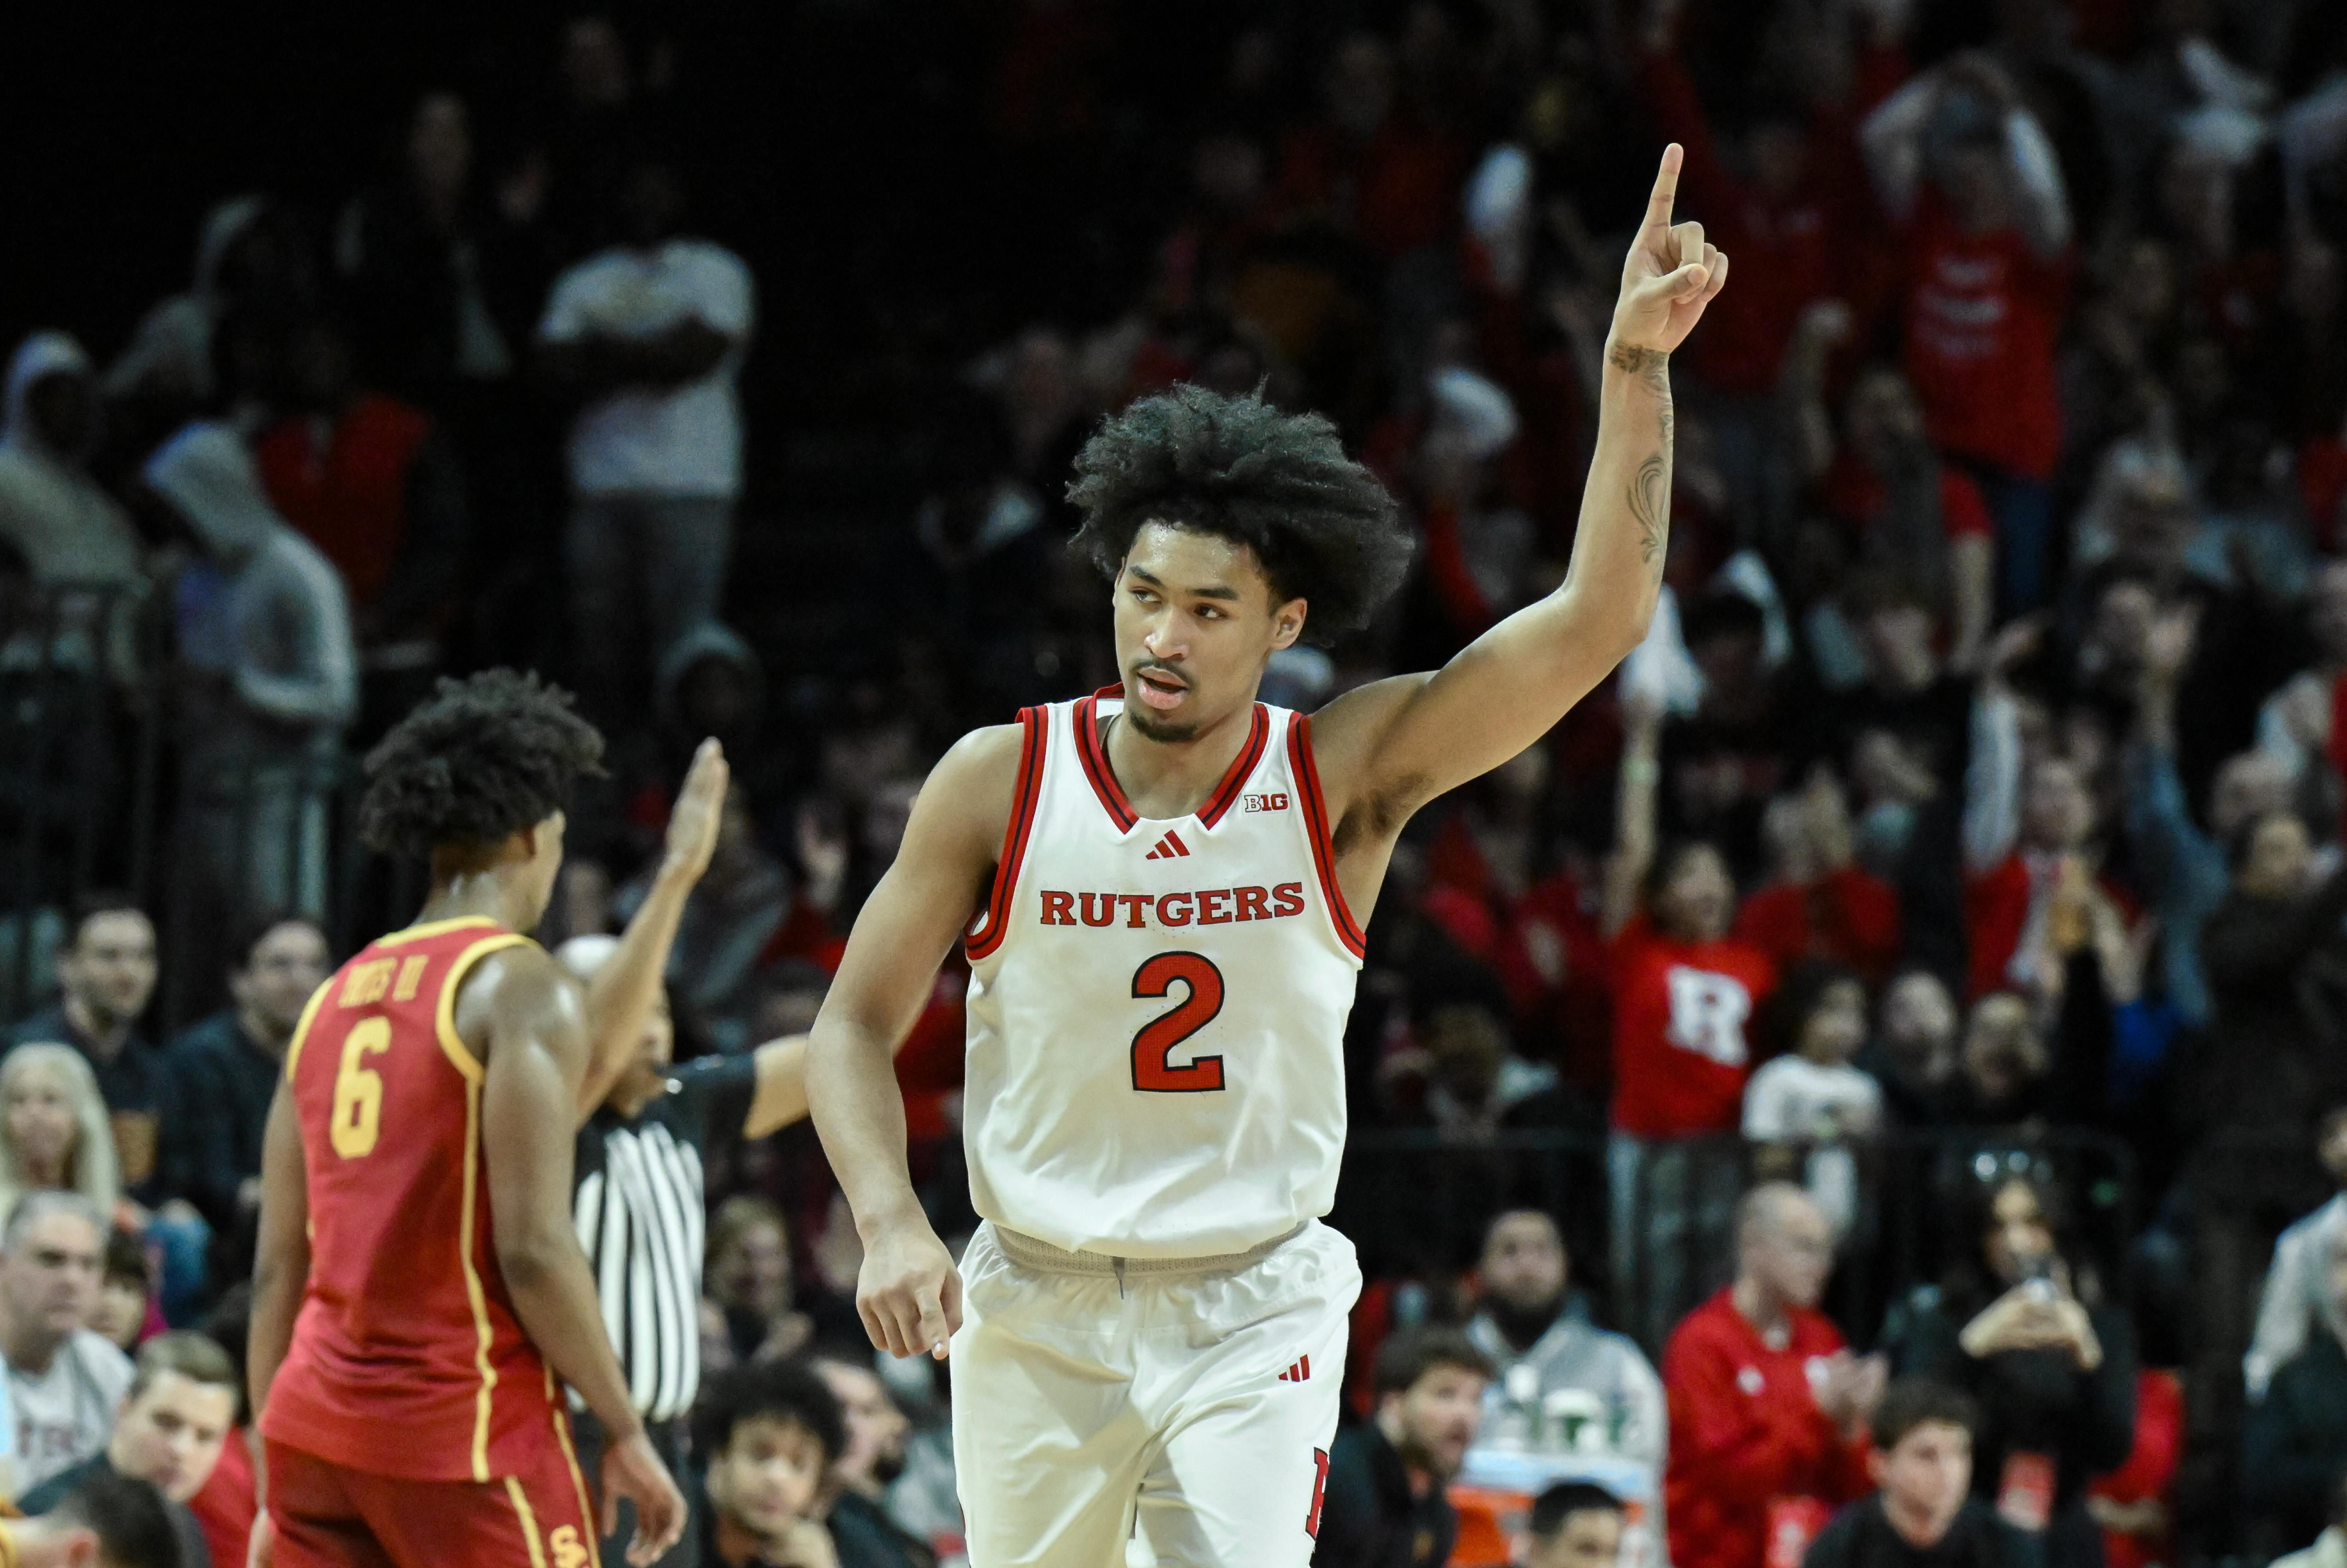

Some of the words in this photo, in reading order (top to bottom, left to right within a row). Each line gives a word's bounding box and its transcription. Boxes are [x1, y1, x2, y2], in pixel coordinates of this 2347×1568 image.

[1040, 882, 1305, 928] RUTGERS
[1131, 951, 1225, 1092] 2
[1665, 964, 1751, 1067] R
[330, 1015, 392, 1159] 6
